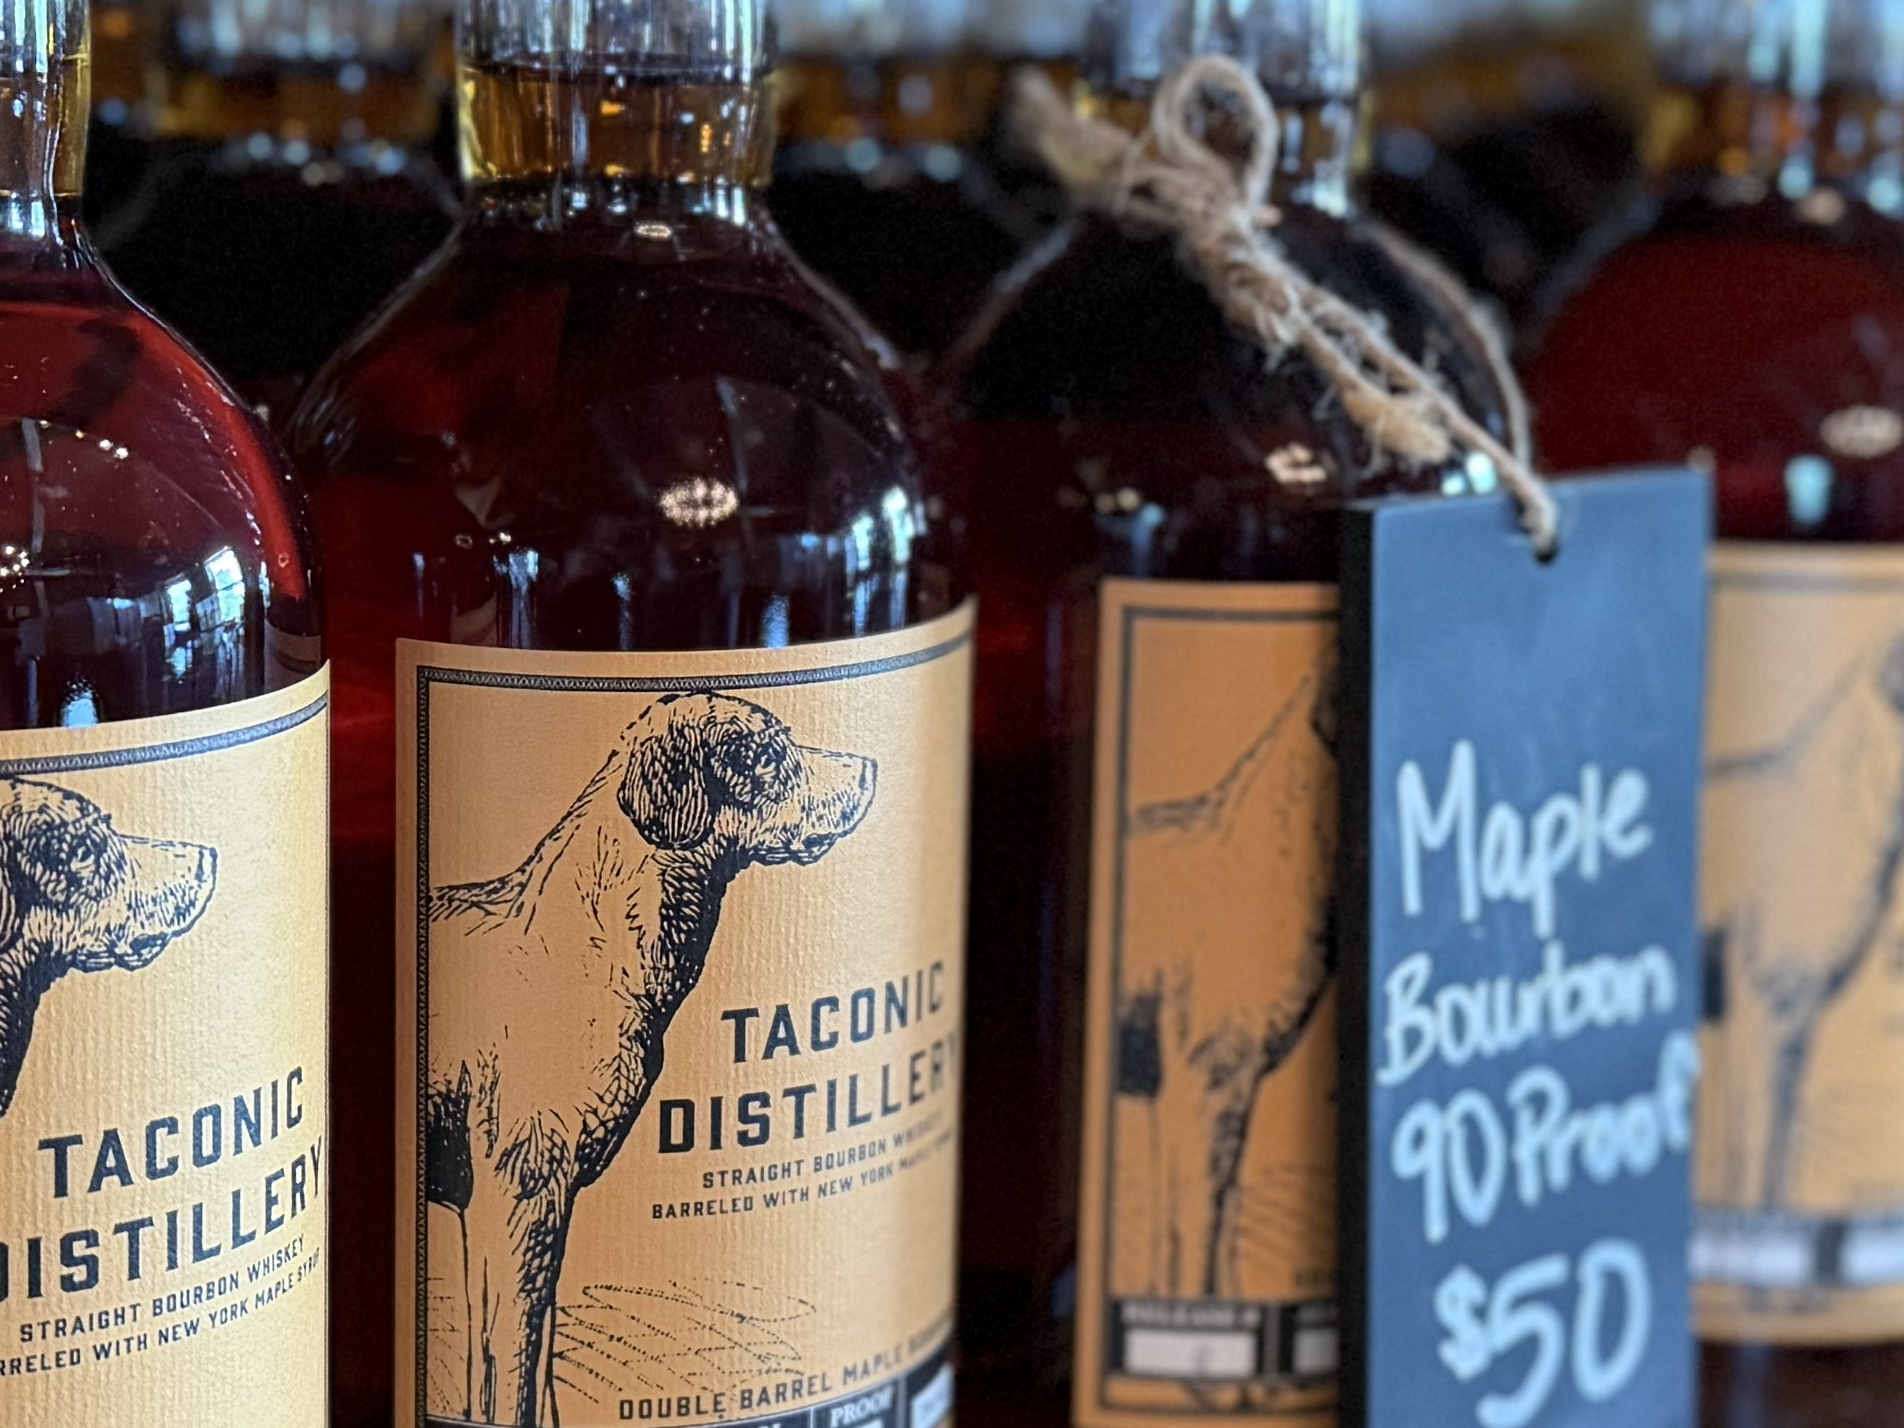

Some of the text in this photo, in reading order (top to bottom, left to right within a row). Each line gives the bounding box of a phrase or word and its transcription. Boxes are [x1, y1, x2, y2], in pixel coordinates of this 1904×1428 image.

[1397, 738, 1653, 939] Maple
[720, 959, 943, 1064] TACONIC
[1376, 940, 1677, 1085] Bourbon
[37, 1066, 303, 1198] TACONIC
[702, 1159, 804, 1188] STRAIGHT
[814, 1138, 886, 1172] BOURBON
[1393, 1030, 1700, 1243] 90 Proof
[652, 1164, 893, 1219] BARRELED WITH NEW YORK
[19, 1233, 305, 1343] STRAIGHT BOURBON WHISKEY
[92, 1334, 148, 1361] WITH
[158, 1316, 200, 1347] NEW
[208, 1298, 250, 1329] YORK
[255, 1273, 294, 1310] MAPLE
[619, 1392, 726, 1420] DOUBLE
[740, 1371, 832, 1410] BARREL
[830, 1384, 894, 1428] PROOF
